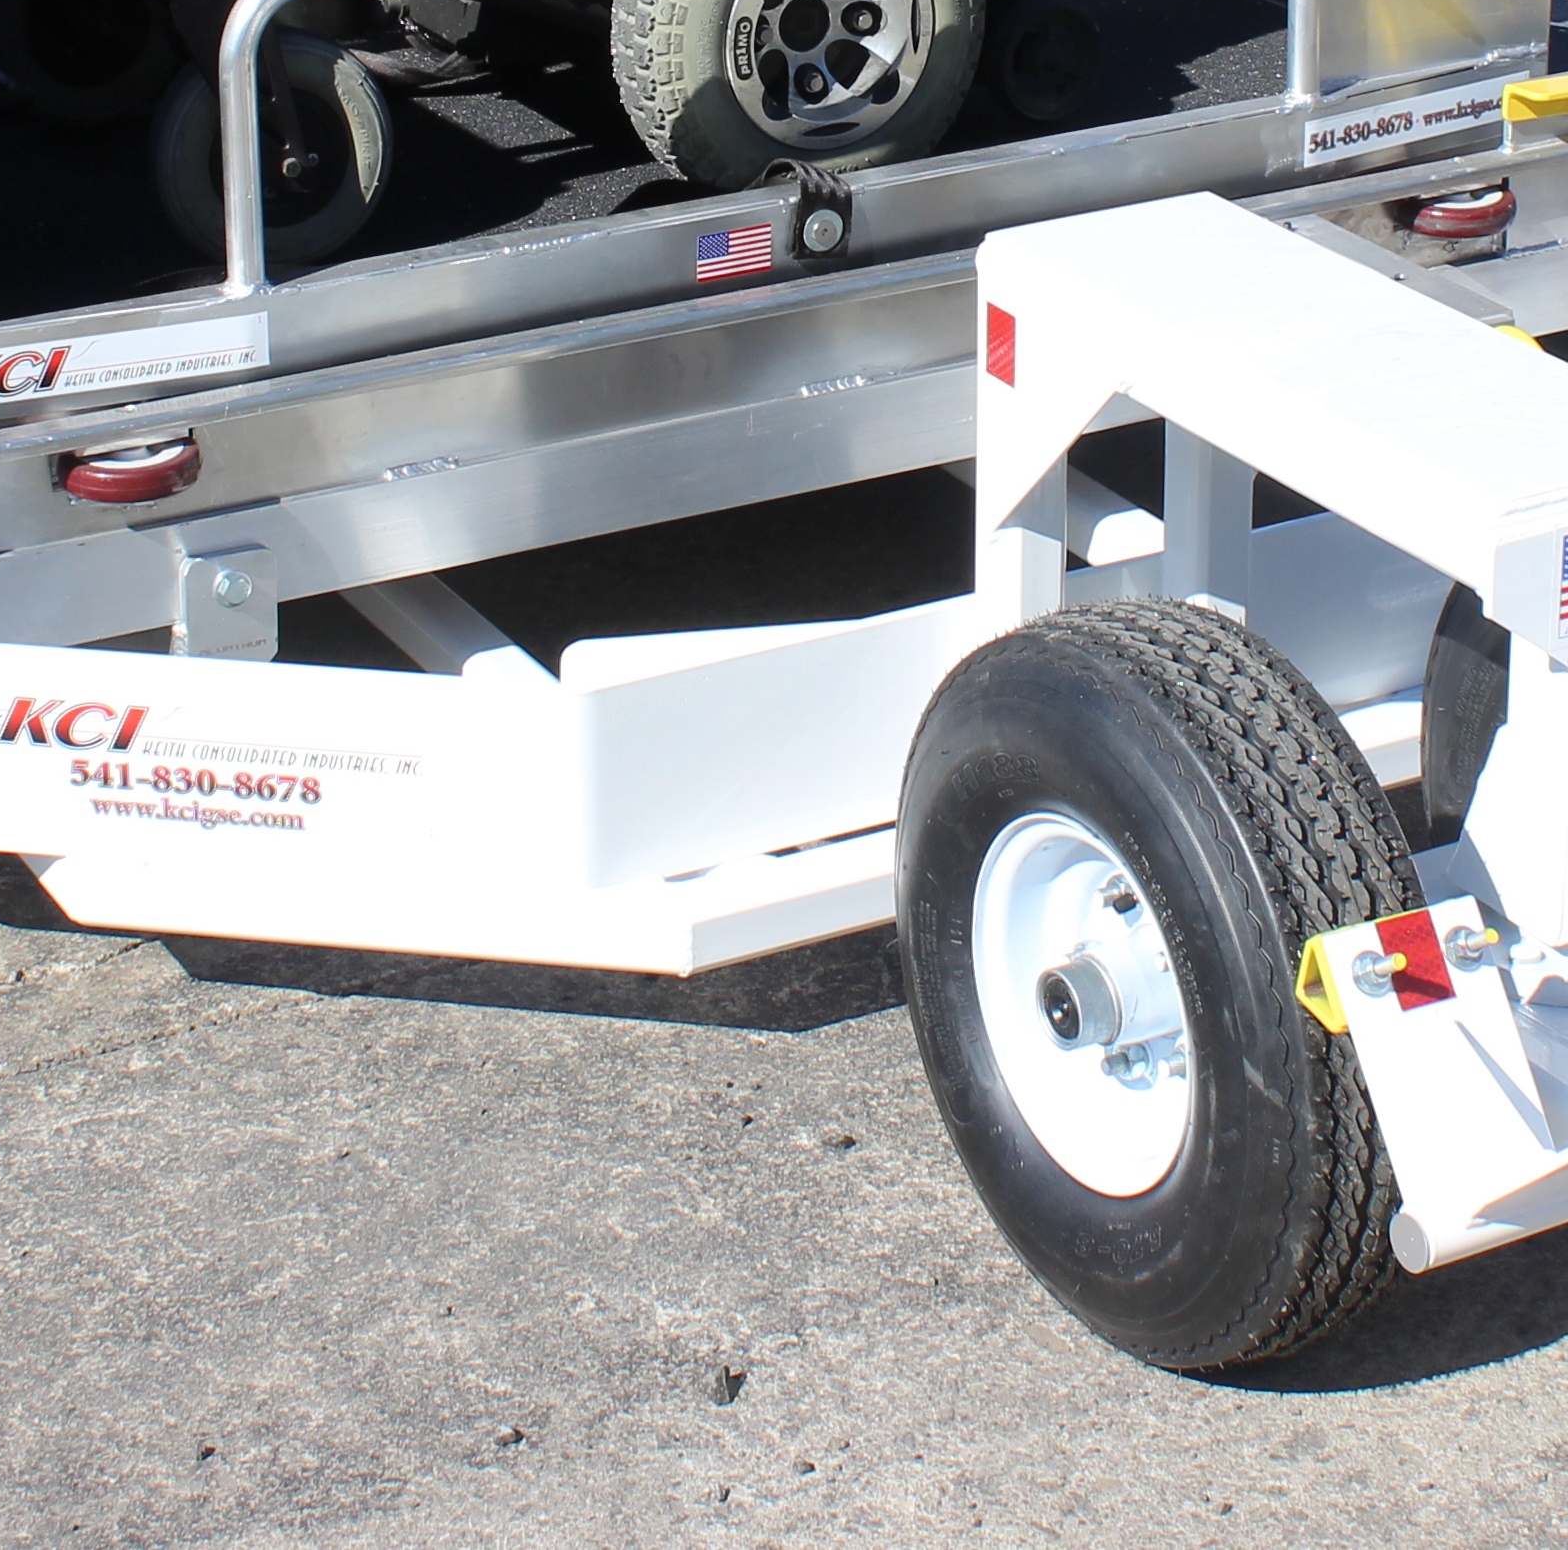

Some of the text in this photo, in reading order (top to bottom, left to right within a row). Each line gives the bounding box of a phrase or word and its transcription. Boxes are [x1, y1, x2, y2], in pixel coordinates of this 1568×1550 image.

[1308, 96, 1503, 154] 541-830-8678 www.kcigse.c
[64, 372, 96, 388] KEITH
[99, 361, 173, 384] CONSOLIDATED
[238, 349, 257, 364] INC.
[142, 740, 186, 758] KEITH
[192, 743, 298, 768] CONSOLIDATED
[395, 759, 423, 777] INC.
[69, 758, 323, 804] 541-830-8678
[89, 796, 306, 831] www.kcigse.com
